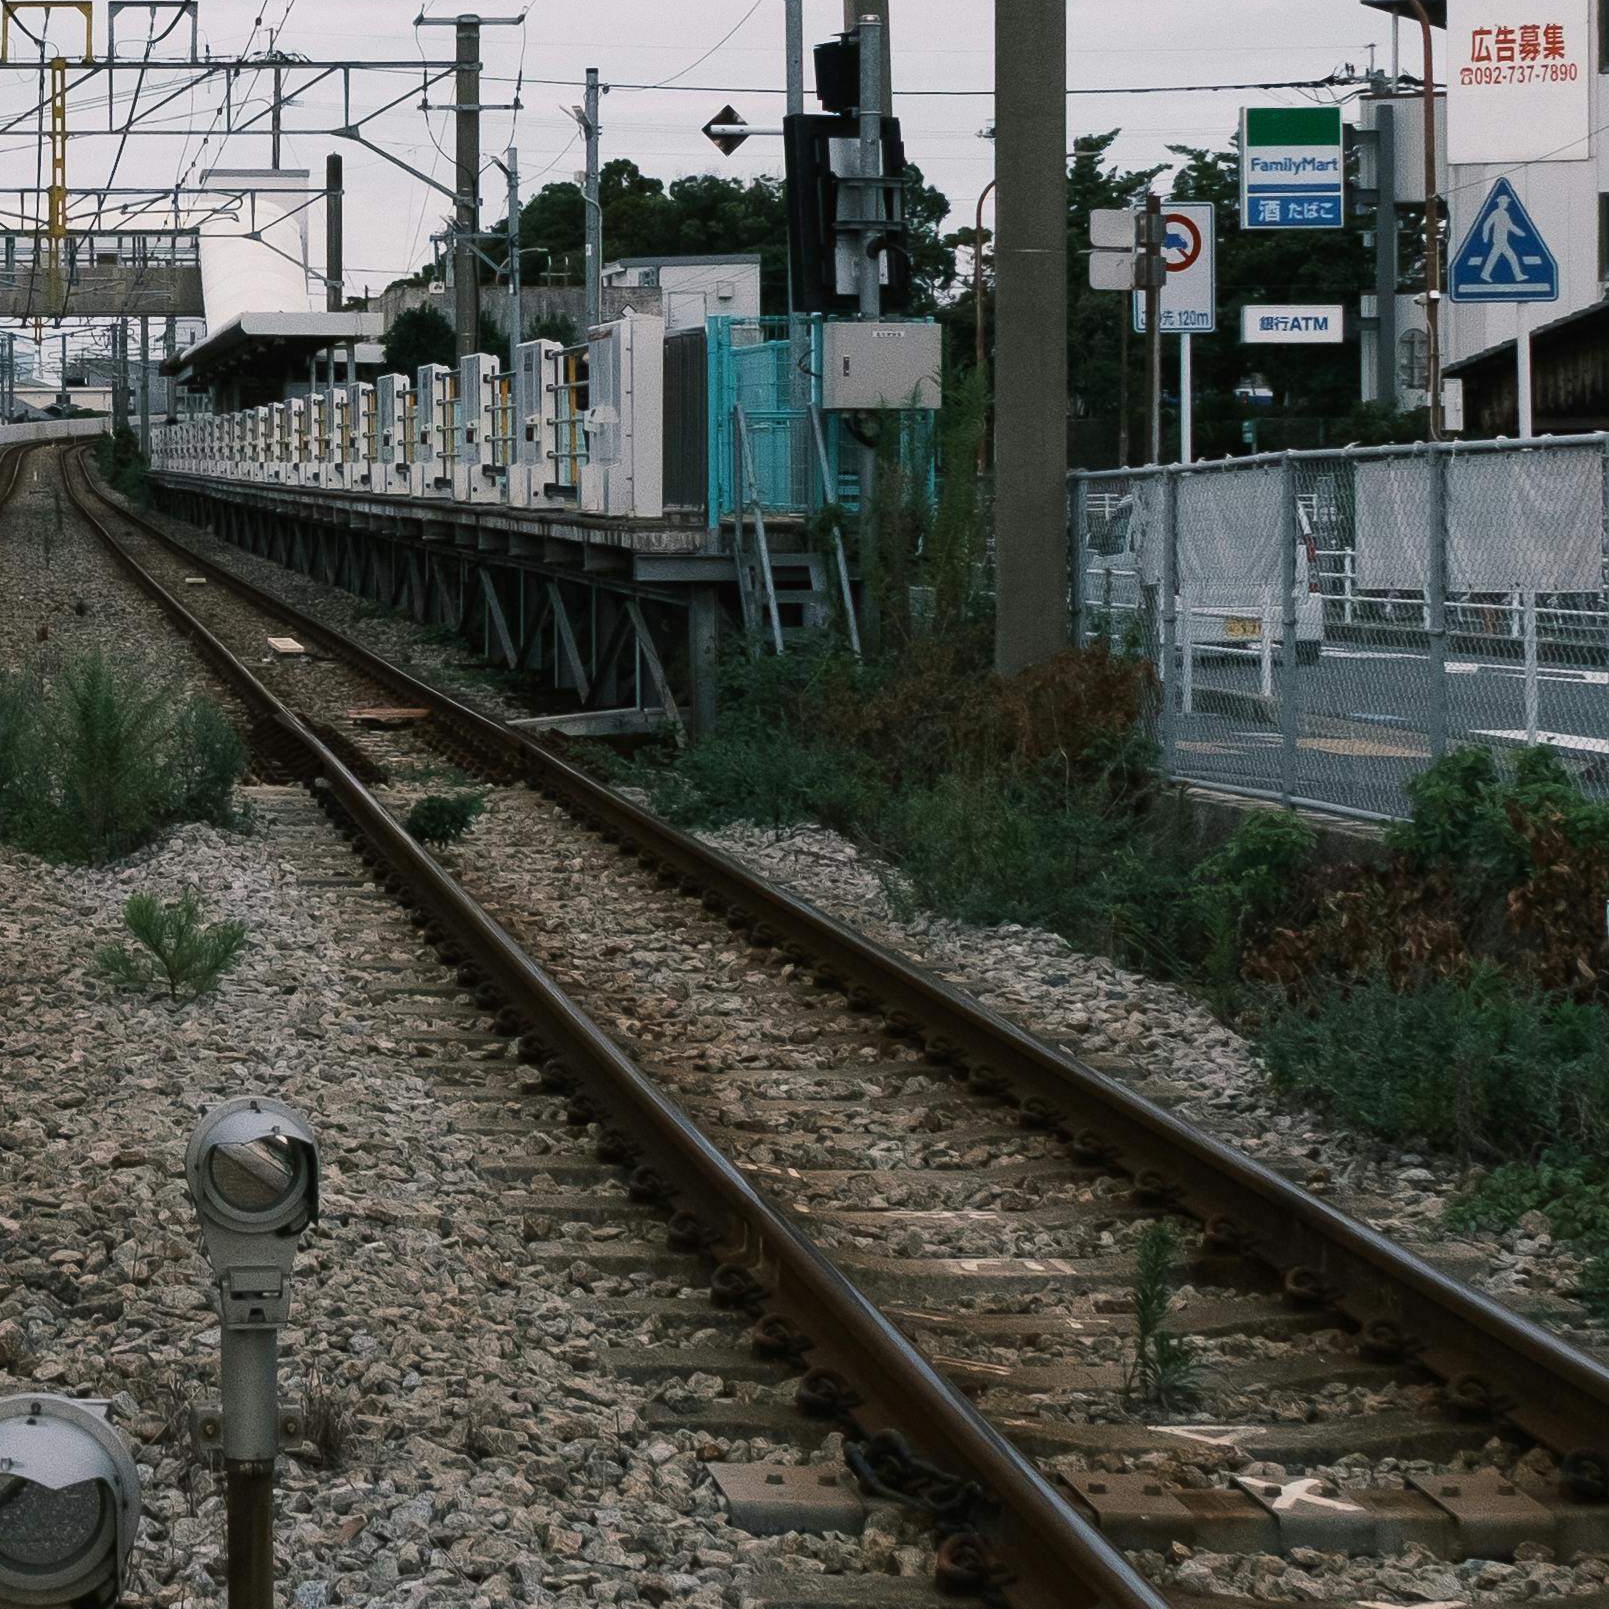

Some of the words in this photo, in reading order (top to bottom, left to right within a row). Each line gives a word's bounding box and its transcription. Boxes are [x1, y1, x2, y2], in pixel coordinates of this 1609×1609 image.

[1471, 23, 1565, 63] 広告募集
[1474, 63, 1578, 85] 092-737-7890
[1251, 157, 1338, 175] FamilyMart
[1258, 200, 1281, 222] 酒
[1288, 201, 1334, 219] たばこ
[1177, 310, 1209, 326] 120m
[1259, 316, 1329, 332] 銀行ATM
